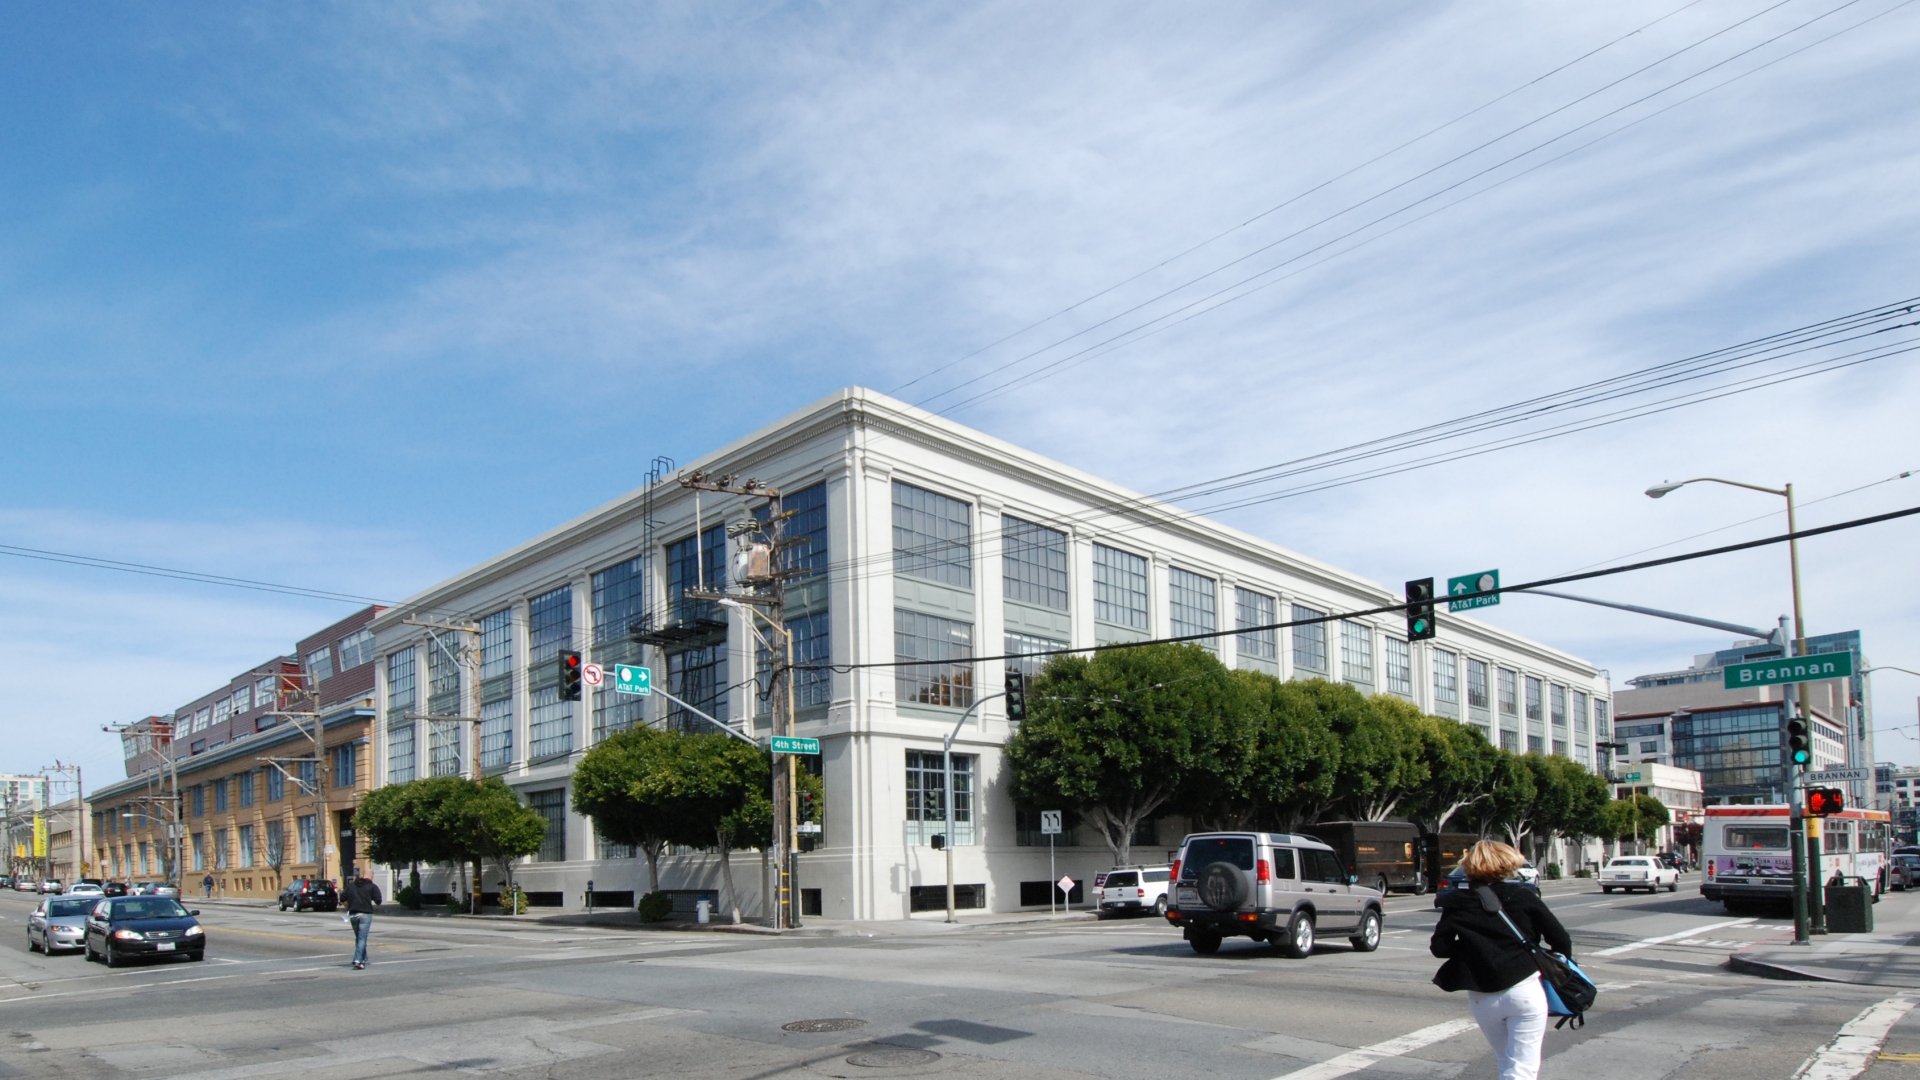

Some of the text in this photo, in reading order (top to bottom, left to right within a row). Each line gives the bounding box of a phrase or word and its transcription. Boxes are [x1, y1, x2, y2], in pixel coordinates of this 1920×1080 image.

[1451, 594, 1497, 610] AT&T Park
[1739, 662, 1835, 682] Brannan
[618, 683, 649, 693] AT&T Park
[775, 740, 816, 751] 4th Street
[1810, 771, 1860, 781] BRANNAN
[1832, 793, 1842, 806] 4
[1676, 939, 1757, 948] BUS
